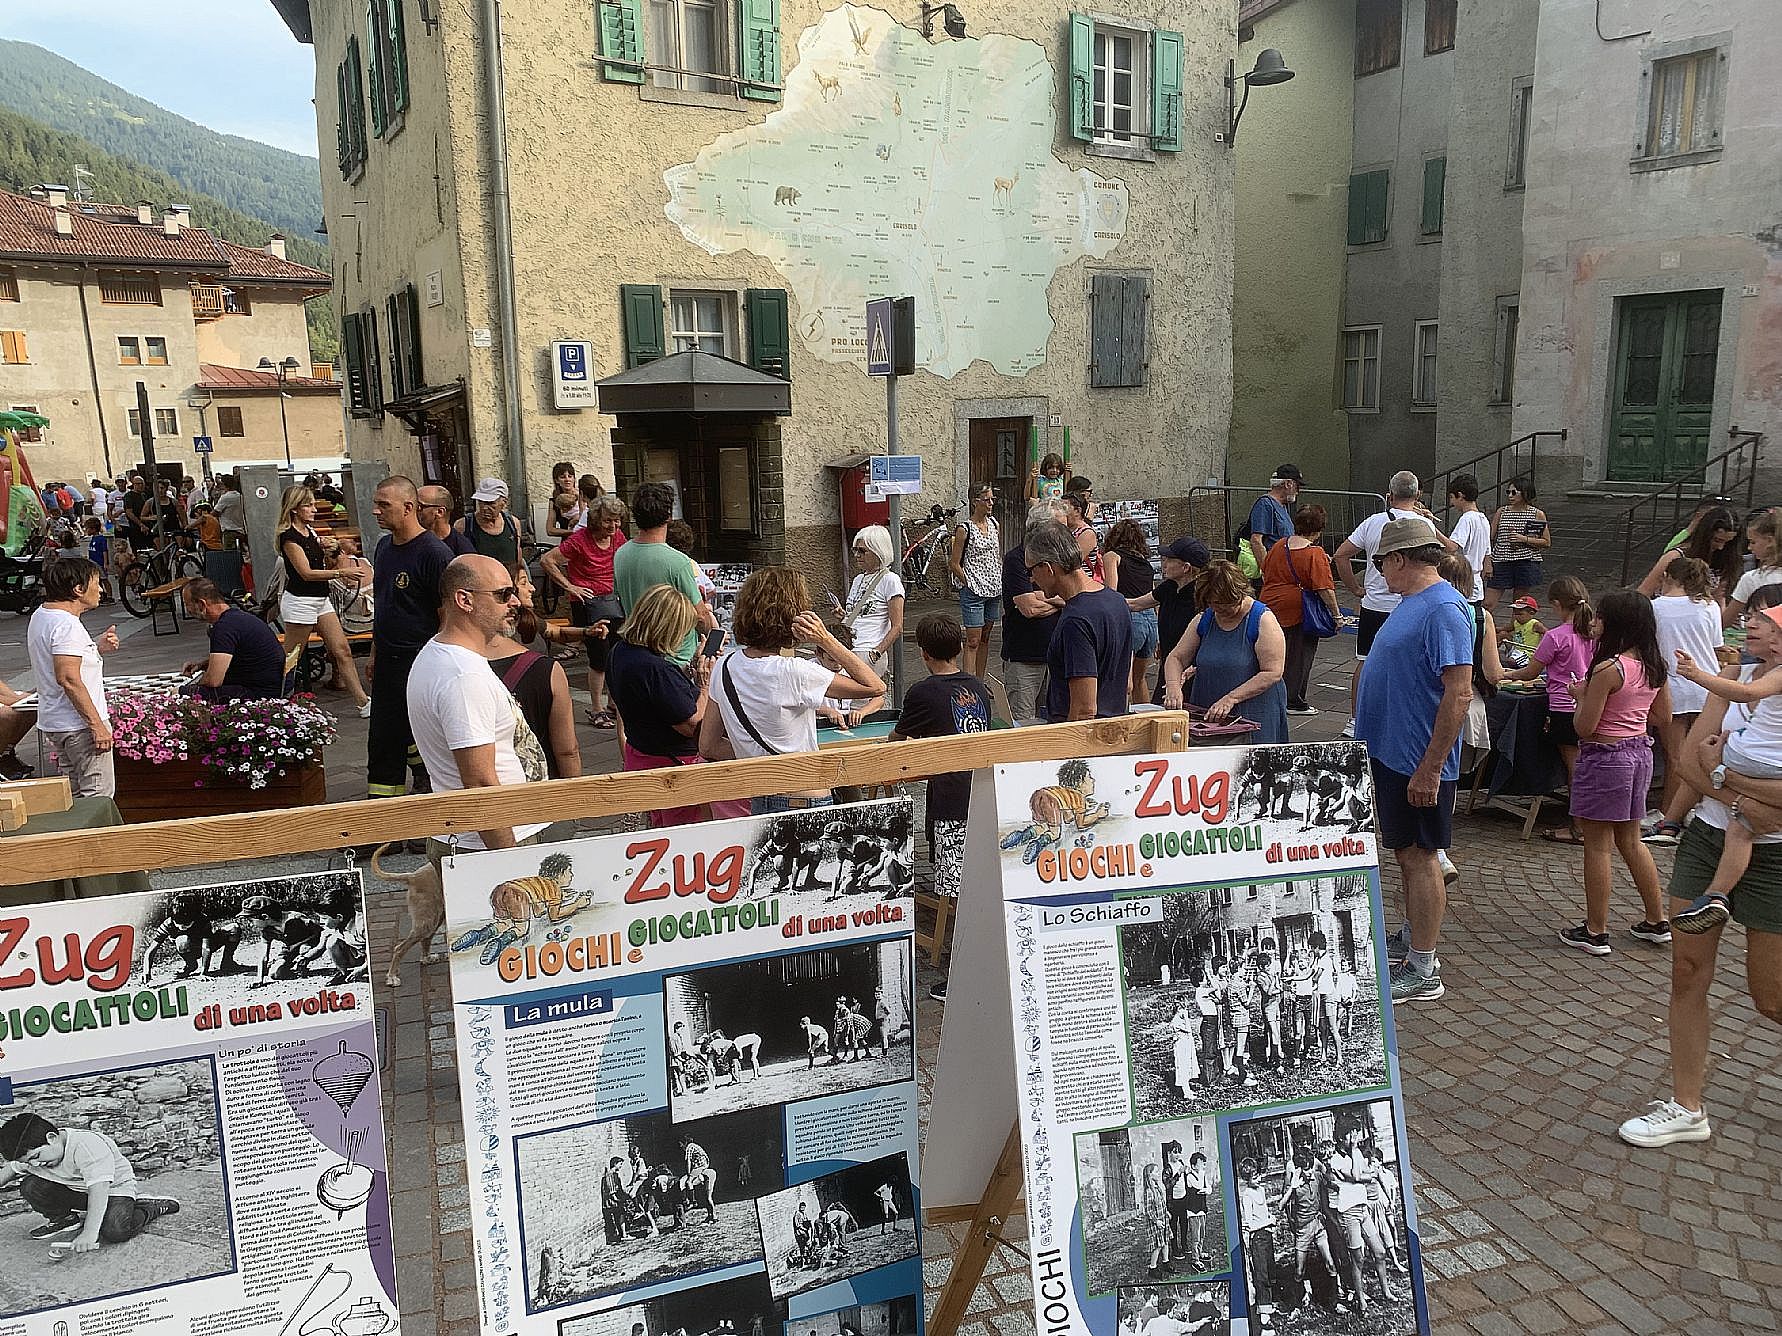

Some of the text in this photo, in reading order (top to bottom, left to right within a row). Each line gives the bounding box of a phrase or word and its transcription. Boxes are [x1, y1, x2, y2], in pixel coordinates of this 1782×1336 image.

[569, 349, 576, 358] P
[1134, 760, 1230, 824] Zug
[624, 838, 745, 906] Zug
[1037, 824, 1366, 883] GIOCHI e GIOCATTOLI di una volta
[497, 899, 904, 982] GIOCHI e GIOCATTOLI di una volta
[1043, 902, 1151, 926] Lo Schiaffo
[0, 986, 357, 1042] IOCATTOLI di una volta
[514, 995, 603, 1022] La mula
[218, 1039, 307, 1059] Un po' di storia
[1037, 1248, 1070, 1336] IOCHI
